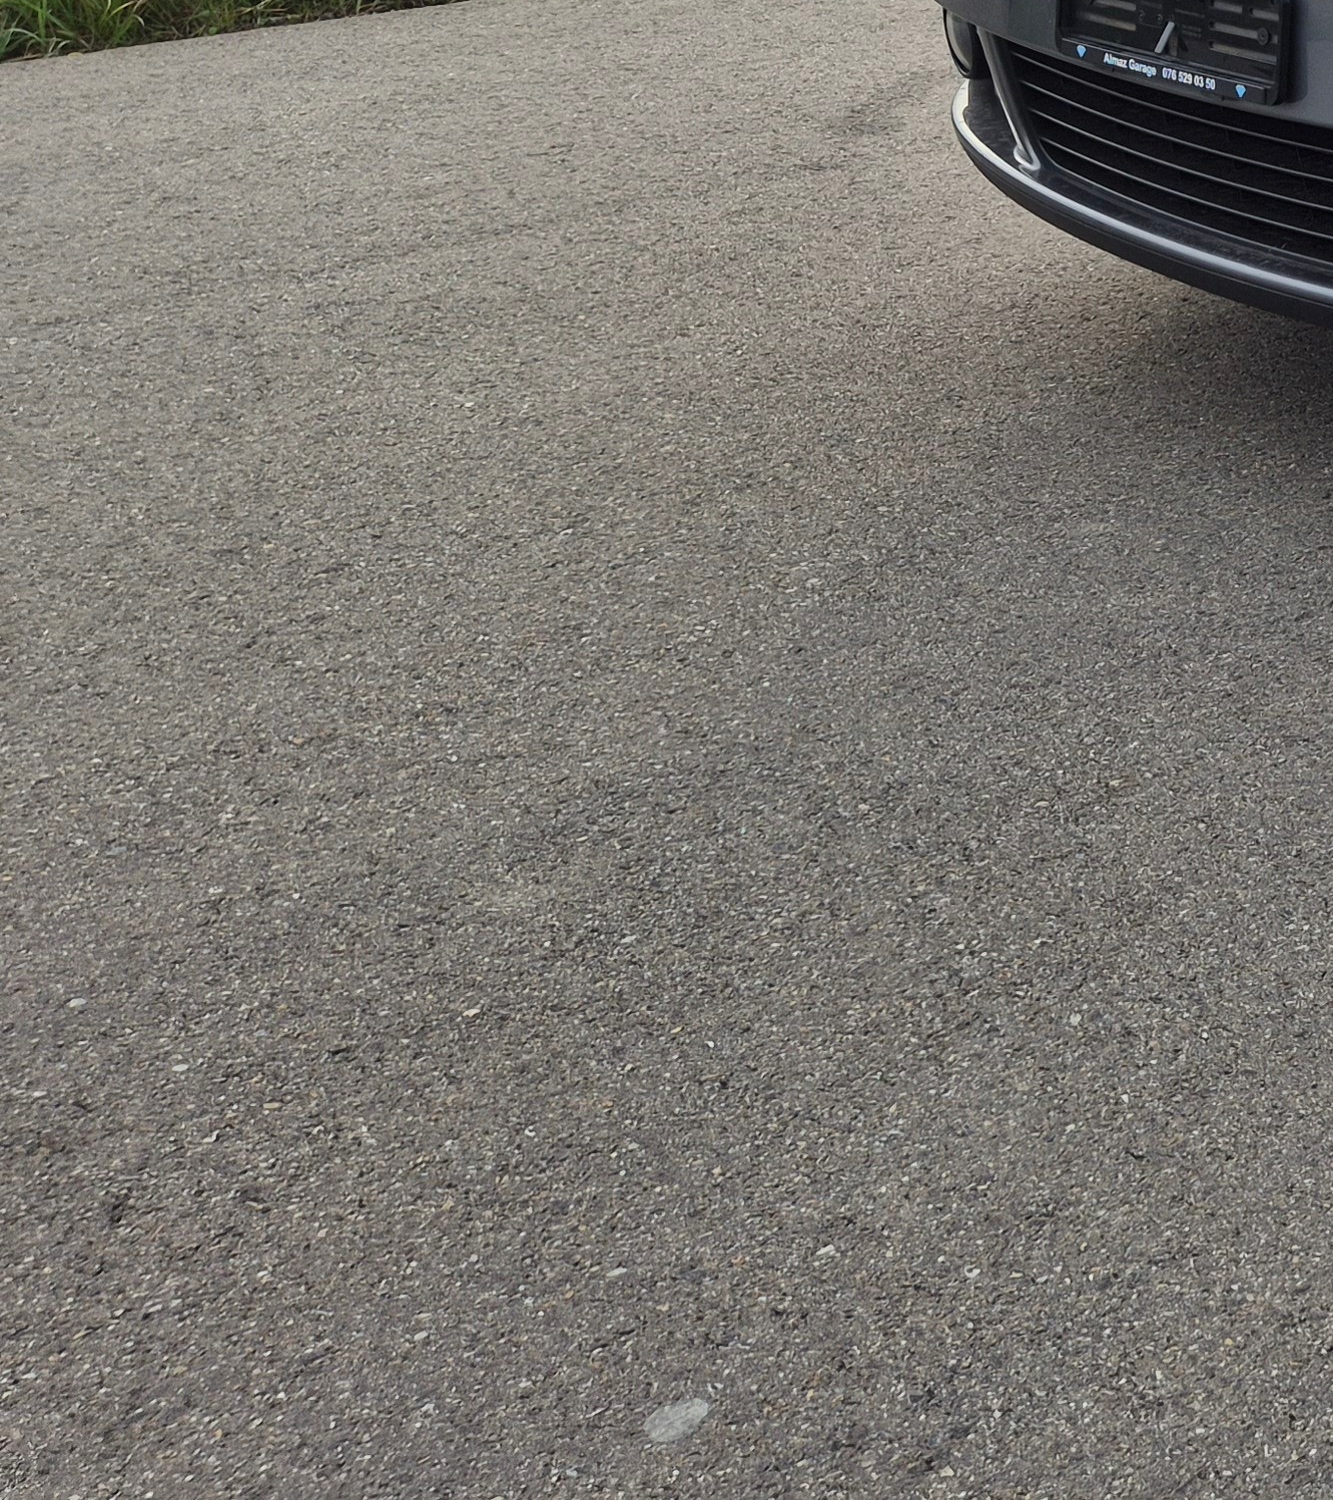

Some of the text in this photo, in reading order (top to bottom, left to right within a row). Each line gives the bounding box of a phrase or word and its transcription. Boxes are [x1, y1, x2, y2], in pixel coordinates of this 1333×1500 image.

[1128, 58, 1157, 77] Garage
[1162, 67, 1177, 81] 076
[1178, 71, 1193, 85] 529
[1193, 75, 1204, 88] 03
[1205, 78, 1216, 90] 50
